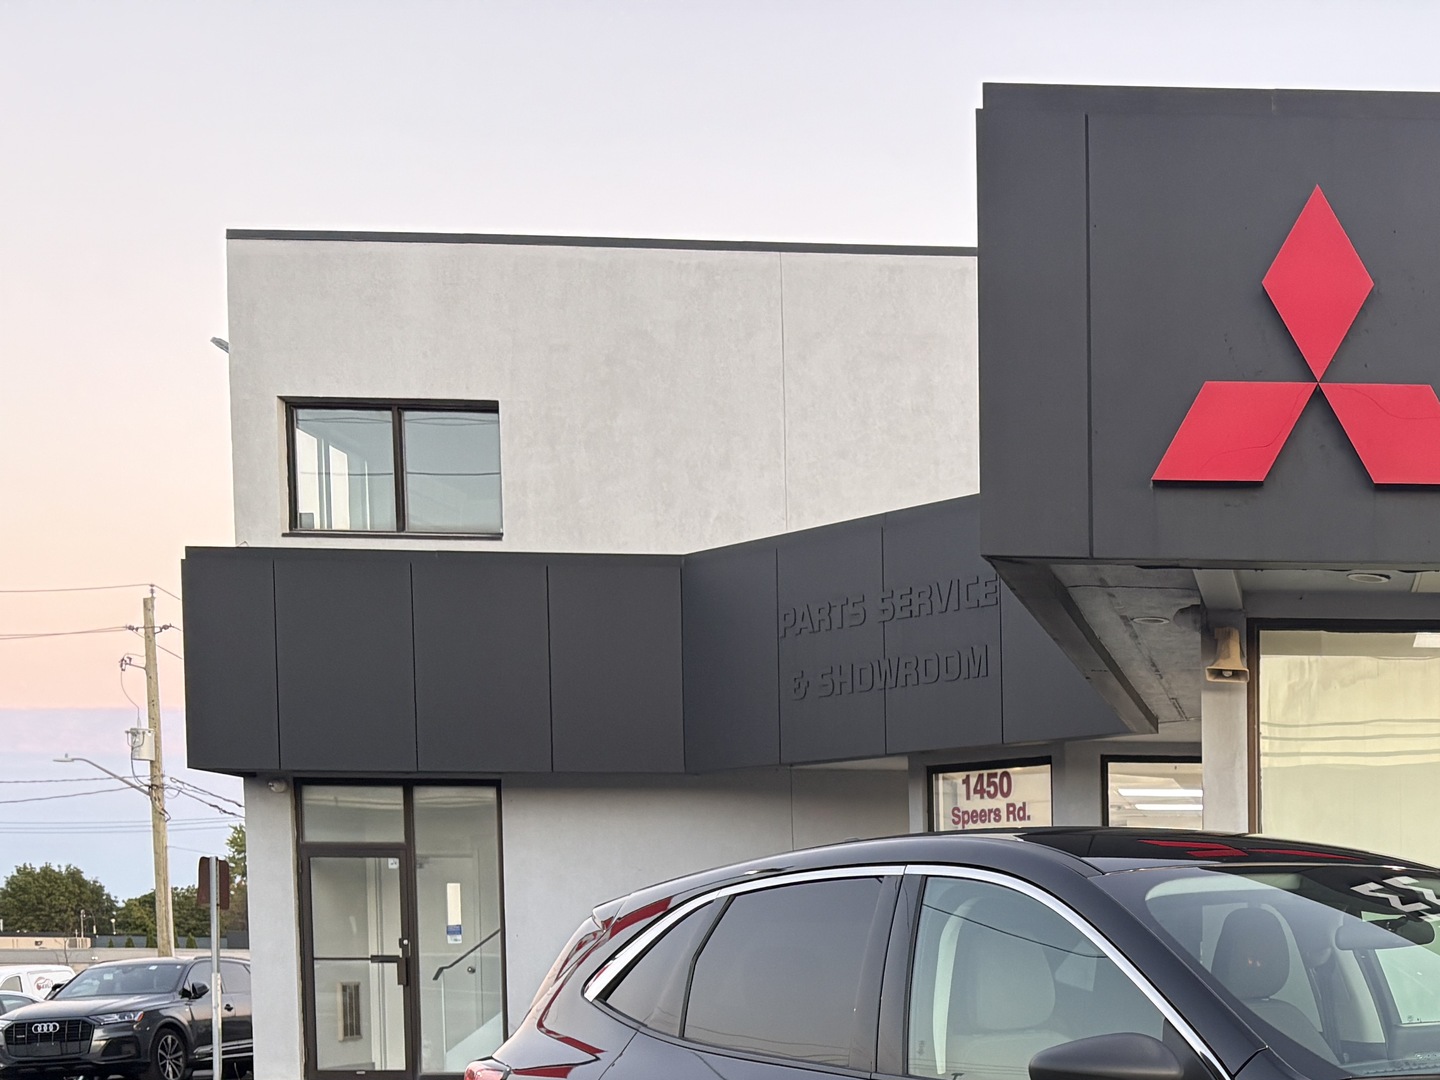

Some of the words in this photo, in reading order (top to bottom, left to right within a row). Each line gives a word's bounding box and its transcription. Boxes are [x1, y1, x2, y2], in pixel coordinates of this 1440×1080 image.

[780, 594, 867, 639] PARTS
[876, 573, 999, 624] SERVICE
[818, 644, 989, 698] SHOWROOM
[962, 771, 1012, 800] 1450
[952, 807, 1002, 829] Speers
[1006, 802, 1031, 822] Rd.
